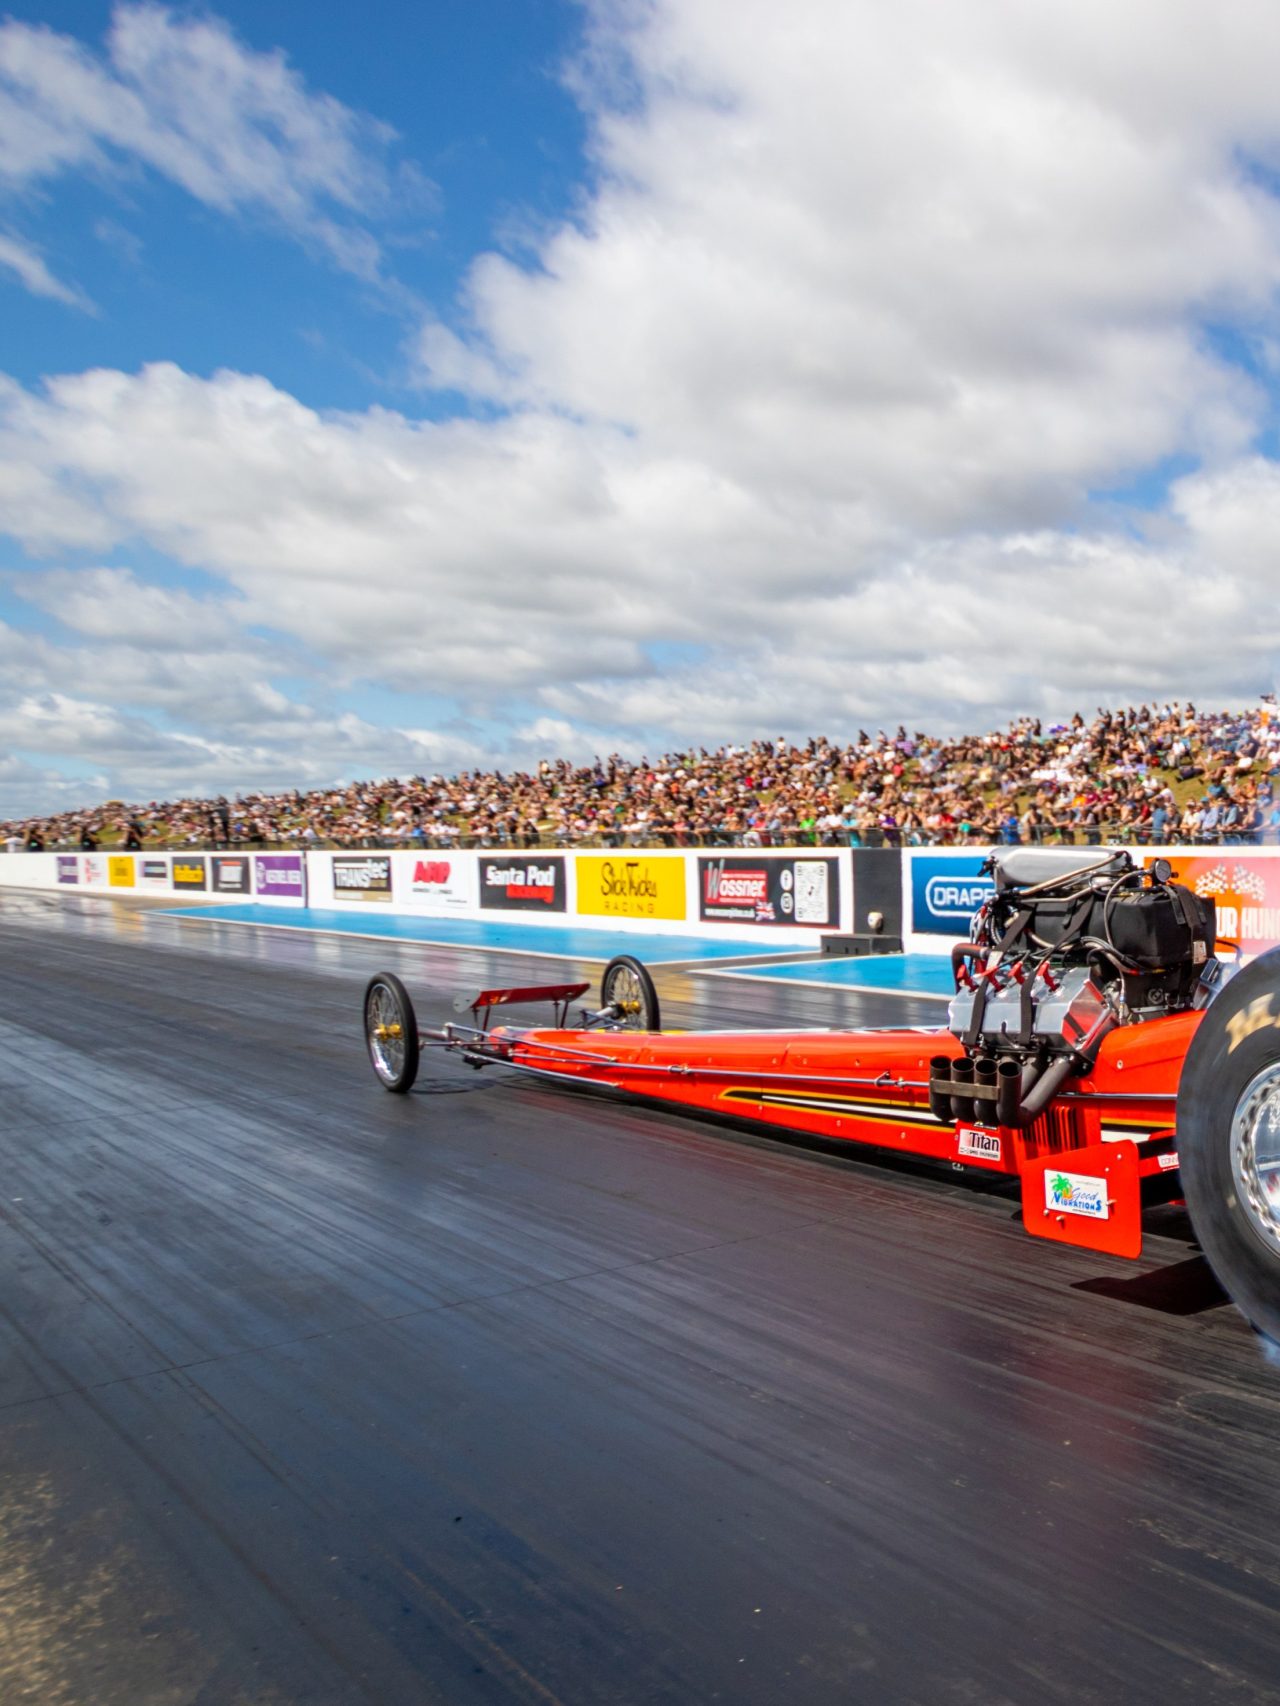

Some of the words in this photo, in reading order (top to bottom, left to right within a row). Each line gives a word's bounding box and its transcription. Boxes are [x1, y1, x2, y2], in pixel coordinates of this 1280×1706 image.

[486, 865, 525, 886] Santa
[527, 865, 556, 887] Pod
[934, 887, 997, 906] DRAPE
[604, 901, 655, 914] RACING
[970, 1132, 999, 1151] Titan
[1053, 1191, 1102, 1212] VIBRATIONS
